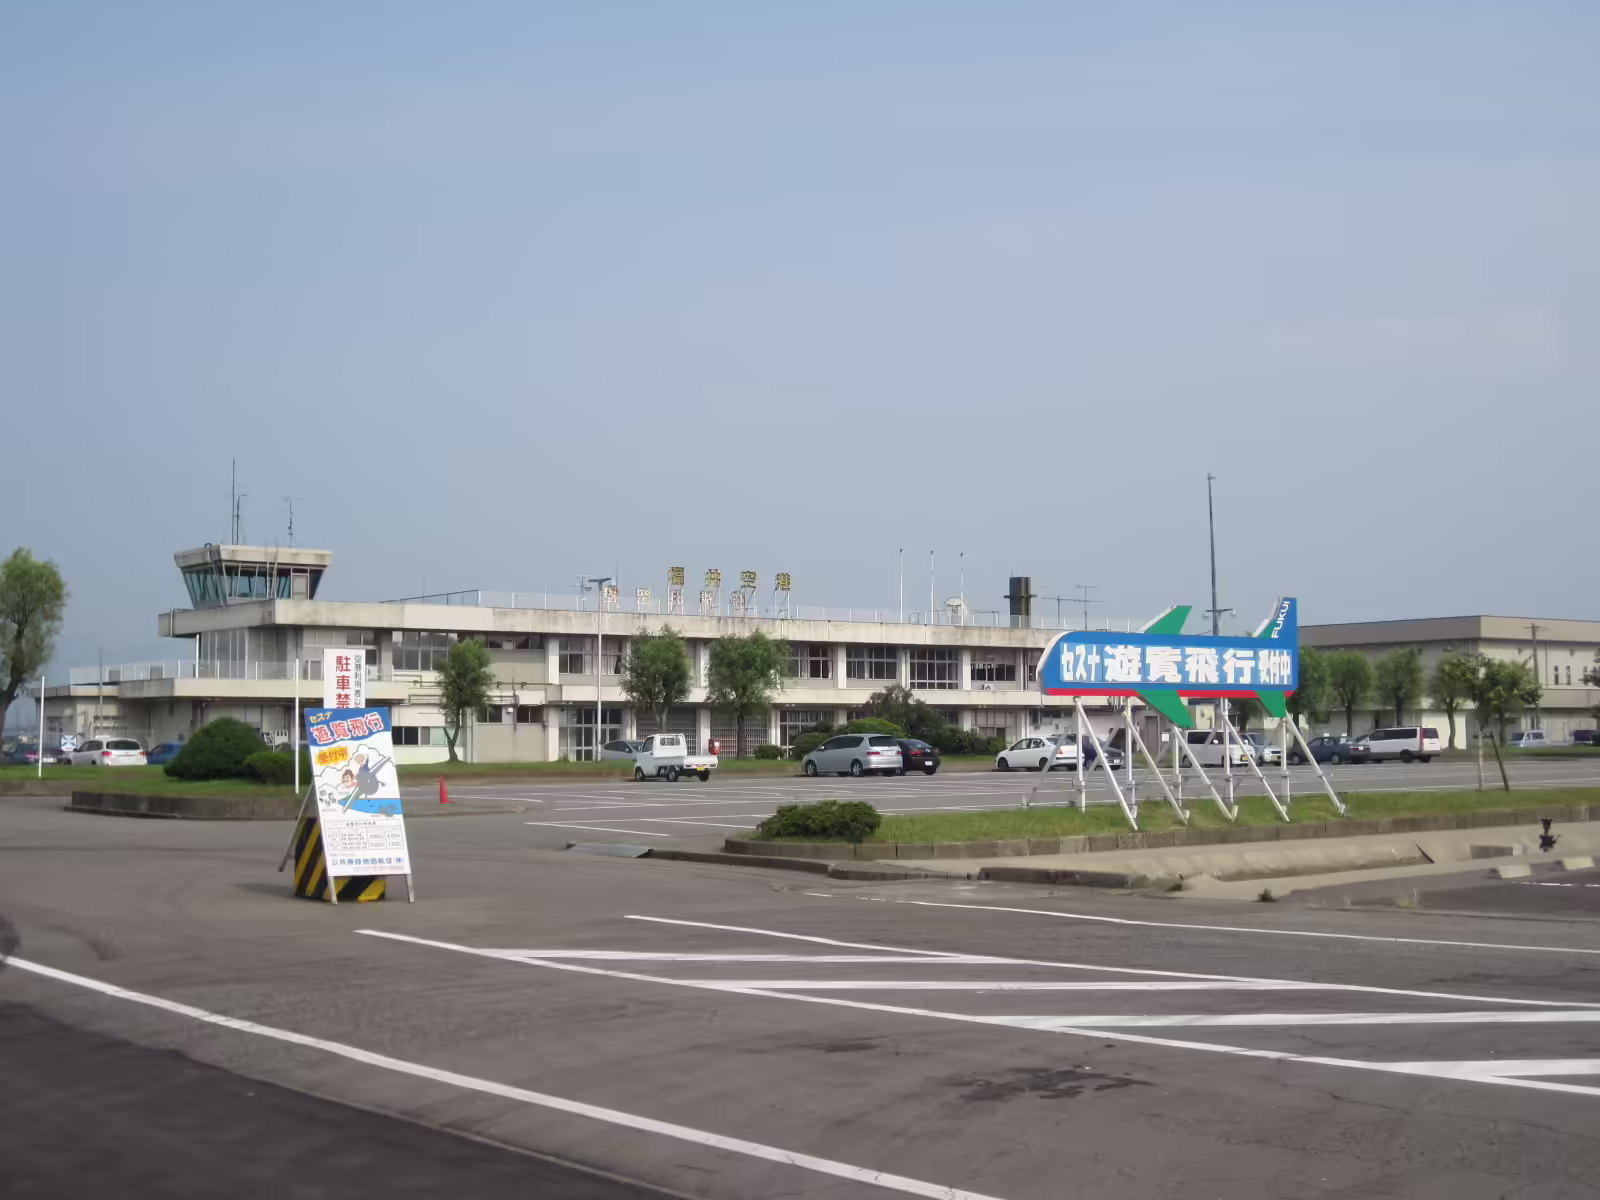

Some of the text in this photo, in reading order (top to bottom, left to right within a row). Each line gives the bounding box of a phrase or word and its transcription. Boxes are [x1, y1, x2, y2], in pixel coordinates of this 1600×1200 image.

[1271, 601, 1291, 639] FUKUI
[1061, 643, 1101, 682] セスナ
[1104, 644, 1256, 684] 遊覧飛行
